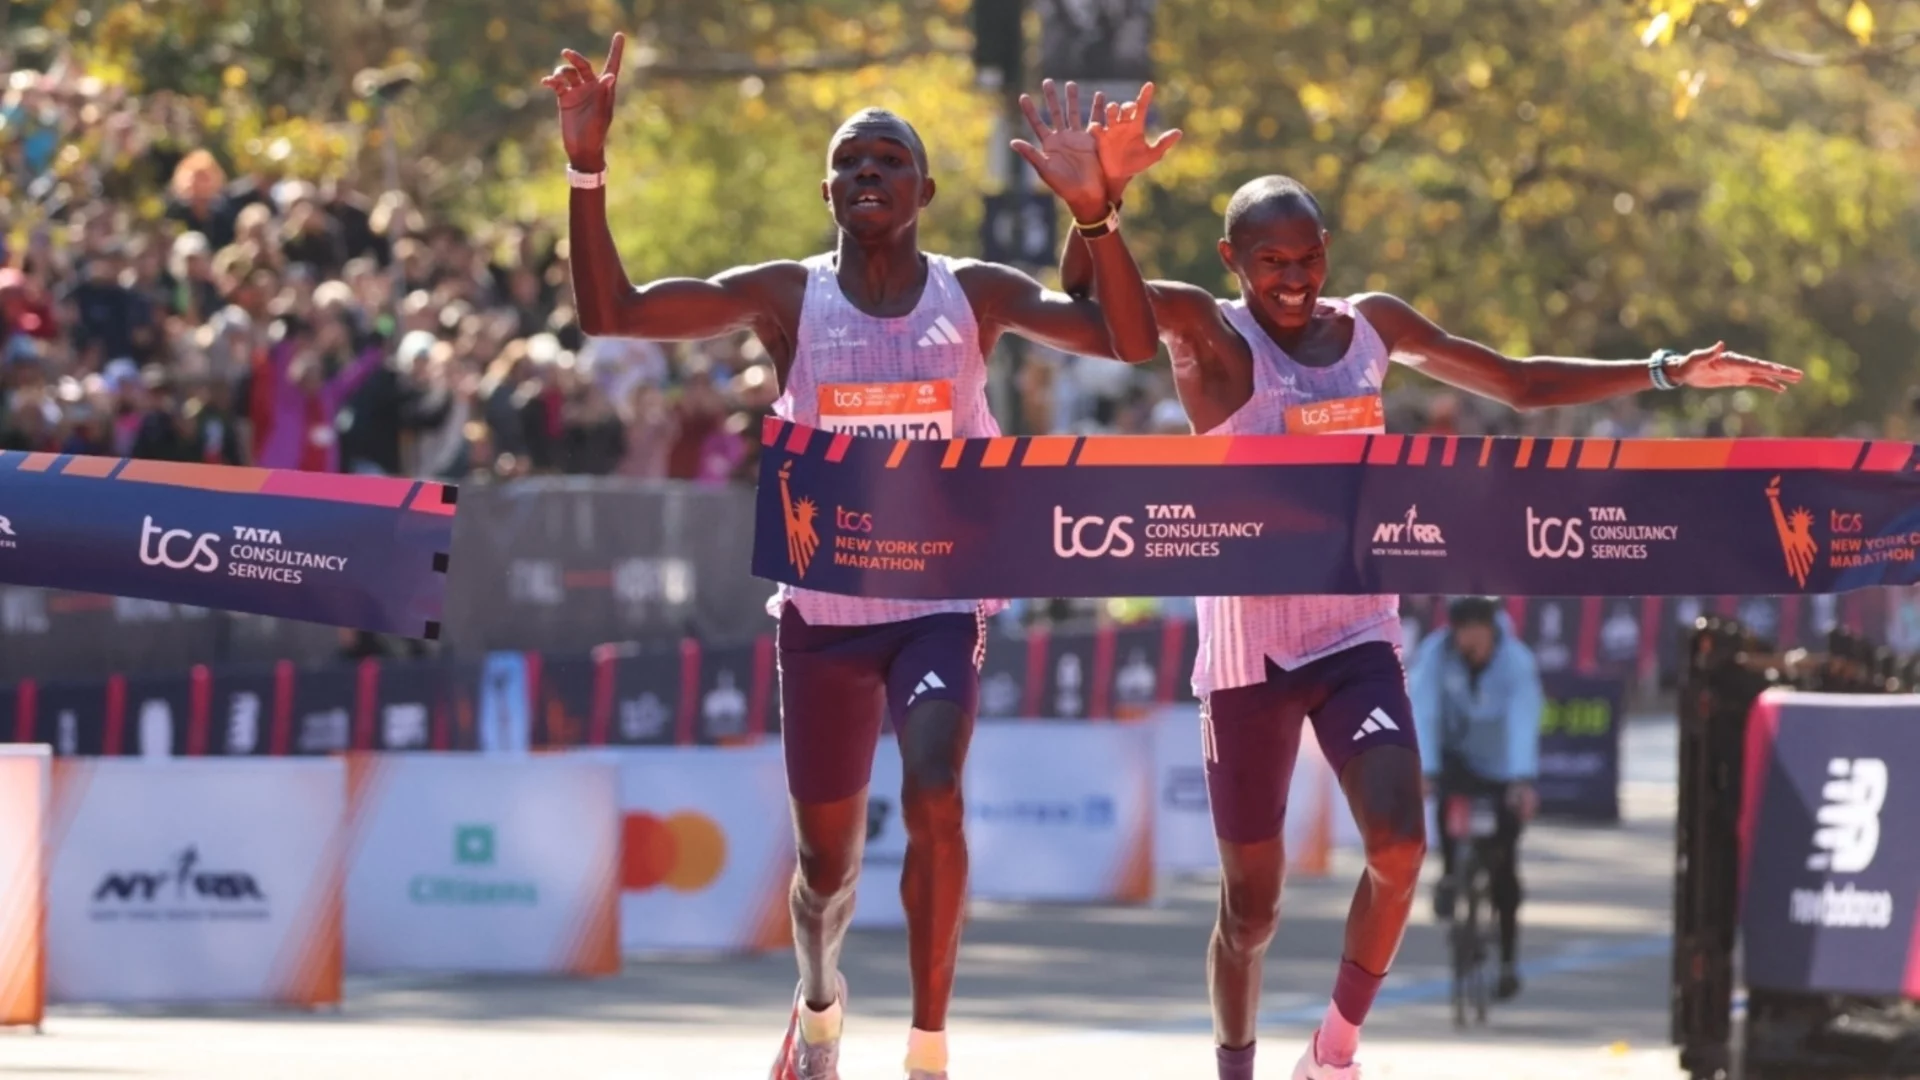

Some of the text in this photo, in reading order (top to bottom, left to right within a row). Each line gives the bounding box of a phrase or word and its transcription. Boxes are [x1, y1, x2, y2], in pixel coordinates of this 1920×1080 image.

[833, 389, 863, 408] tcs
[1301, 408, 1330, 426] tcs
[837, 505, 873, 533] tcs
[1145, 504, 1196, 519] TATA
[1589, 507, 1626, 521] TATA
[1830, 509, 1862, 533] tcs
[233, 526, 282, 545] TATA
[1053, 505, 1135, 558] tcs
[1145, 522, 1263, 538] CONSULTANCY
[1526, 506, 1584, 558] tcs
[1590, 525, 1678, 540] CONSULTANCY
[139, 515, 221, 573] tcs
[835, 536, 954, 555] NEW YORK CITY
[1145, 542, 1220, 558] SERVICES
[1591, 544, 1647, 559] SERVICES
[1831, 539, 1862, 552] NEW
[1865, 534, 1906, 550] YORK
[230, 544, 348, 572] CONSULTANCY
[834, 552, 925, 571] MARATHON
[1830, 548, 1914, 568] MARATHON
[228, 562, 303, 584] SERVICES
